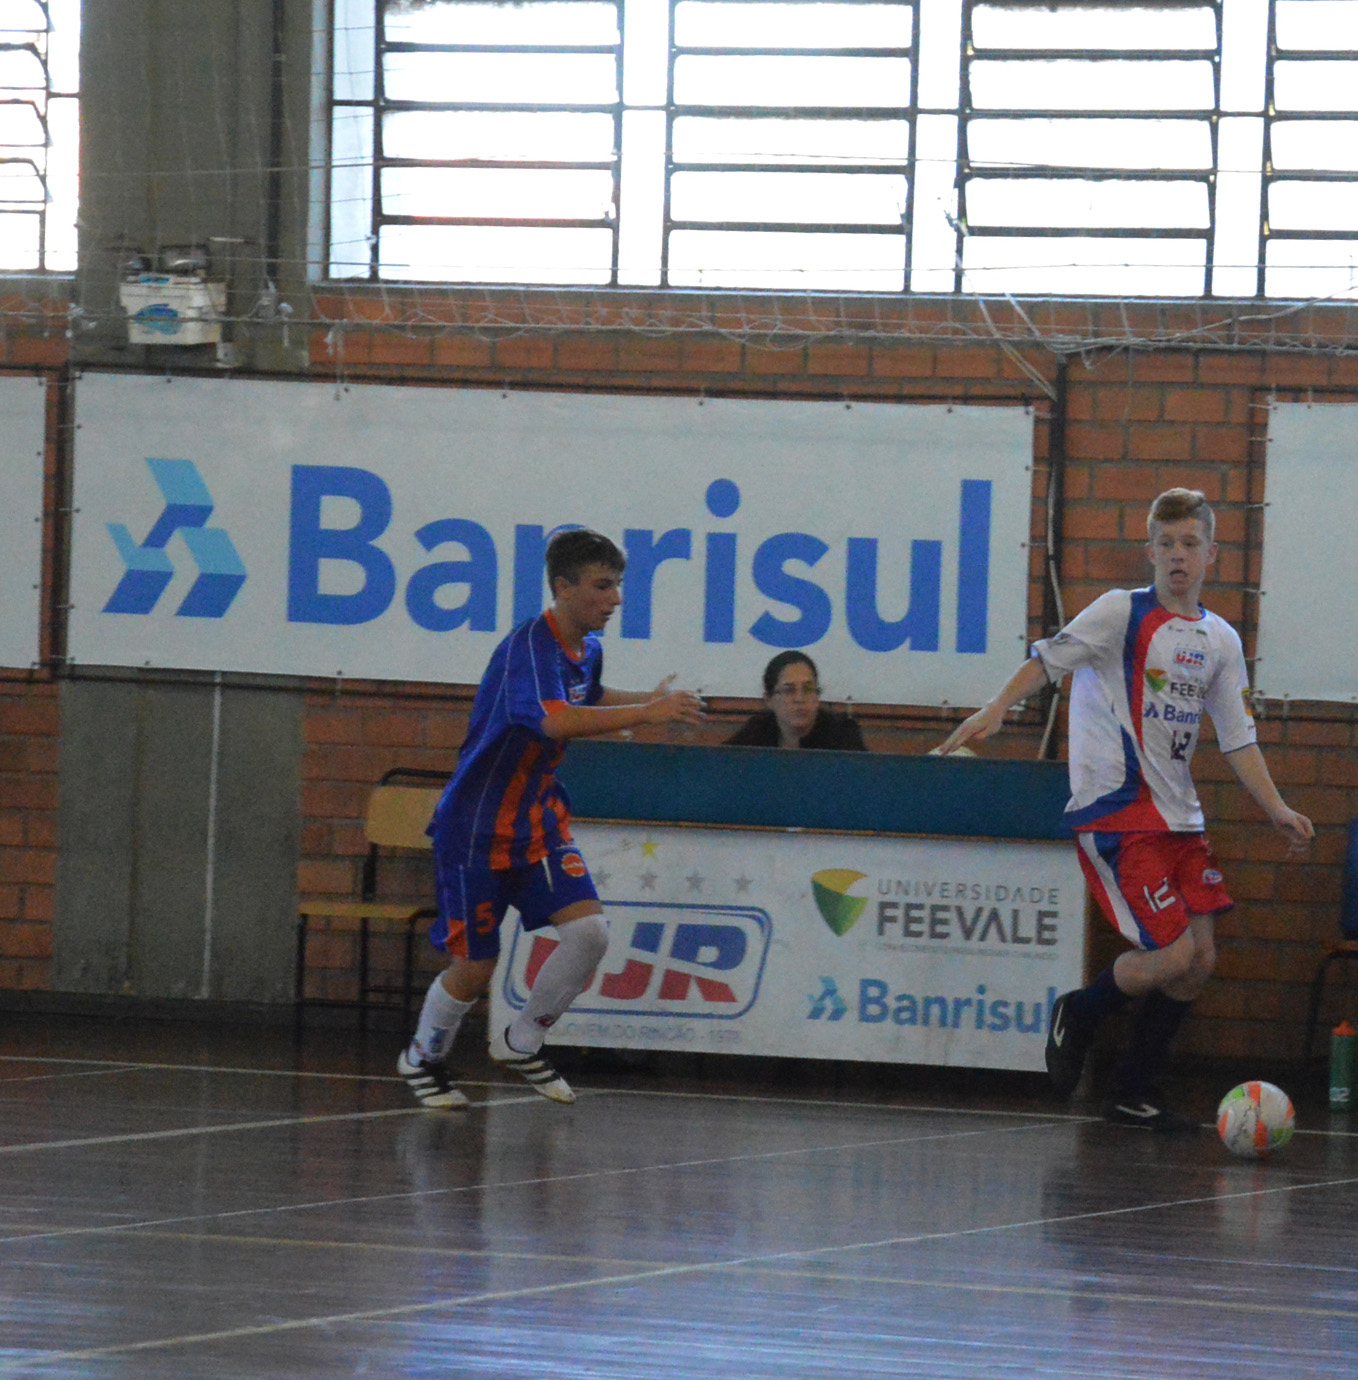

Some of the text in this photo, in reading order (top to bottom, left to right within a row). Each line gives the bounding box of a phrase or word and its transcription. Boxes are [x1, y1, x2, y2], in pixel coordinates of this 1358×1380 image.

[877, 879, 1060, 905] UNIVERSIDADE
[1142, 877, 1176, 913] 12
[475, 902, 495, 934] 5
[877, 901, 1060, 946] FEEVALE
[858, 978, 1058, 1034] Banrisul
